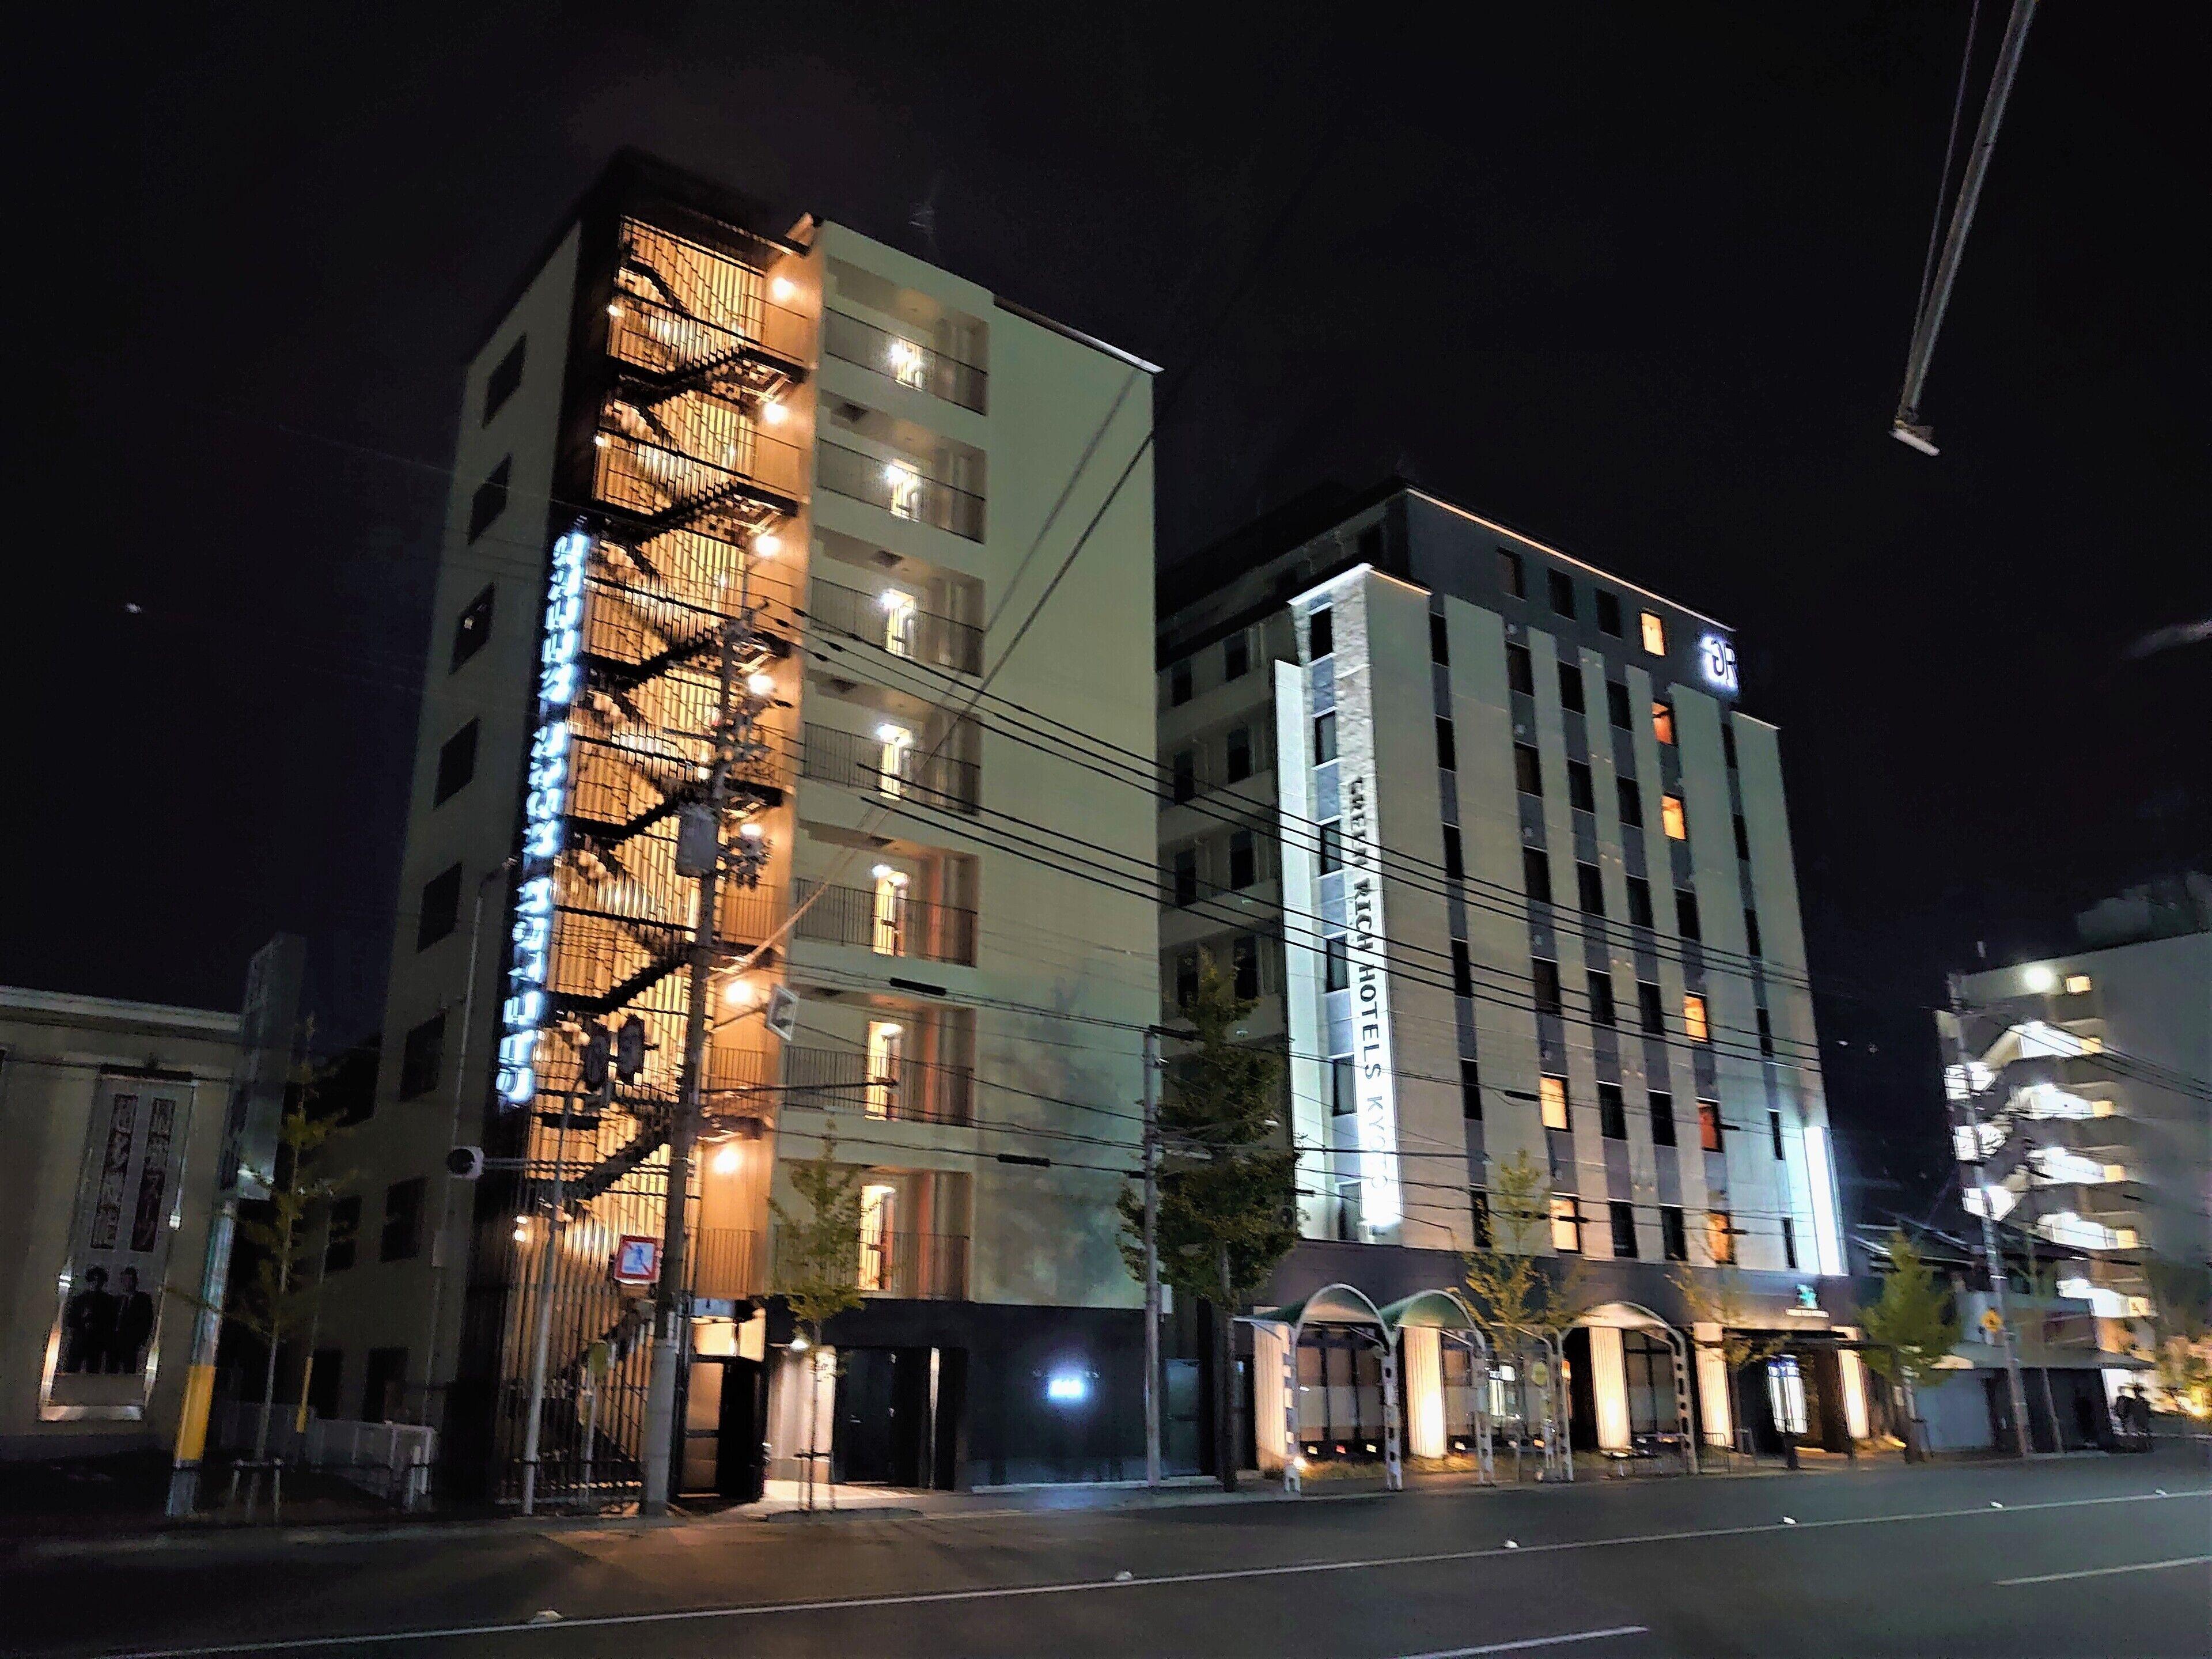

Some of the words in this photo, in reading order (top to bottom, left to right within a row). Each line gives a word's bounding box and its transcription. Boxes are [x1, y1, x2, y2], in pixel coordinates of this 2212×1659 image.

[538, 531, 590, 704] GREEN
[1349, 775, 1368, 869] GREEN
[1354, 877, 1374, 952] RICH
[496, 877, 553, 1103] HOTELS
[1358, 963, 1381, 1079] HOTELS
[1367, 1096, 1389, 1188] KYOTO
